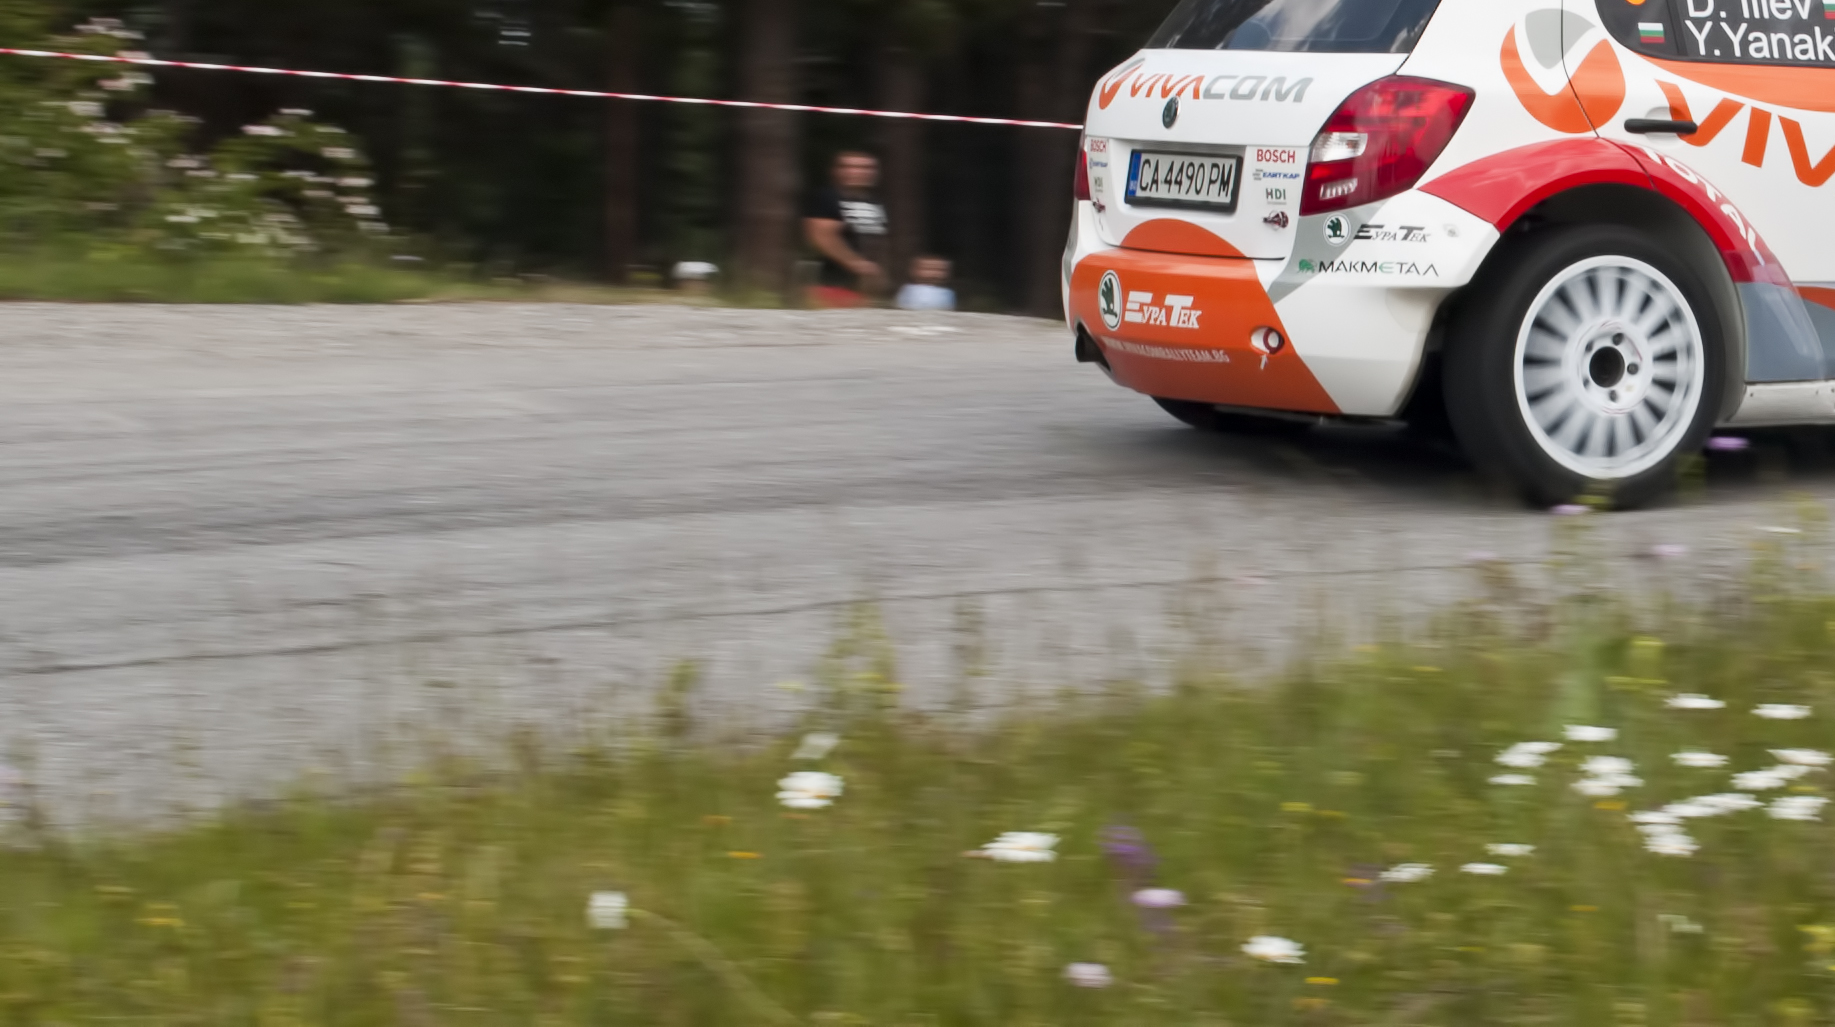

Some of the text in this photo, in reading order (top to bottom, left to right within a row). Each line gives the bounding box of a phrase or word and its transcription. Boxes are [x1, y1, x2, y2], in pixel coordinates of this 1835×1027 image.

[1130, 73, 1313, 103] VIVACOM
[1256, 148, 1296, 163] BOSCH
[1139, 158, 1233, 197] CA 4490 PM
[1266, 188, 1287, 200] HDI
